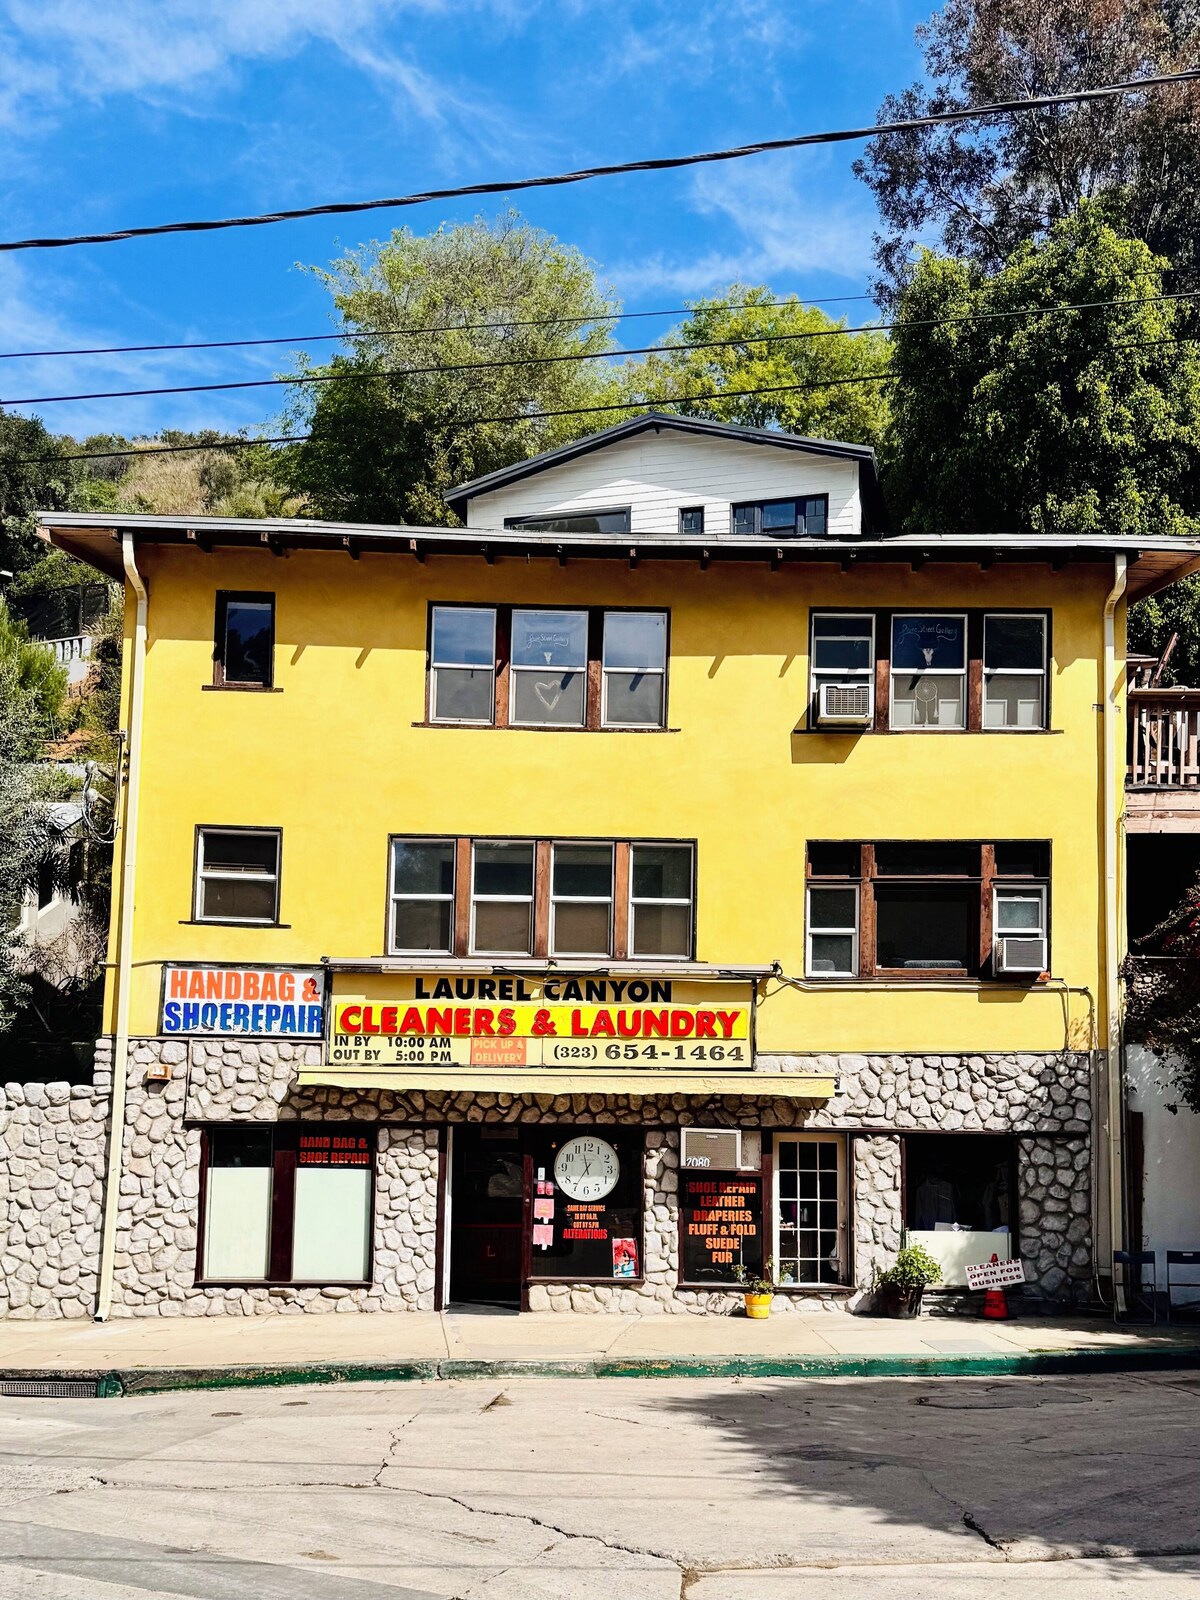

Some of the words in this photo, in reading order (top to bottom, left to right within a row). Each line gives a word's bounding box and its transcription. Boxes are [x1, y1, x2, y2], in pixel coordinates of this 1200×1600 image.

[170, 970, 295, 1001] HANDBAG
[302, 978, 320, 1003] &
[415, 977, 531, 1000] LAUREL
[544, 979, 672, 1003] CANYON
[340, 1005, 517, 1036] CLEANERS
[531, 1009, 557, 1037] &
[571, 1009, 741, 1039] LAUNDRY
[334, 1036, 348, 1046] IN
[354, 1036, 370, 1047] BY
[388, 1037, 425, 1048] 10:00
[429, 1037, 451, 1048] AM
[473, 1038, 498, 1049] PICK
[501, 1038, 514, 1049] UP
[517, 1039, 524, 1049] &
[333, 1050, 360, 1060] OUT
[365, 1050, 381, 1061] BY
[396, 1051, 425, 1061] 5:00
[431, 1051, 451, 1062] PM
[475, 1052, 522, 1063] DELIVERY
[554, 1045, 597, 1060] (323)
[605, 1044, 744, 1061] 654-1464
[300, 1137, 330, 1148] HAND
[333, 1137, 355, 1148] BAG
[358, 1138, 368, 1148] &
[584, 1143, 593, 1152] 12
[575, 1145, 580, 1154] 11
[300, 1152, 328, 1163] SHOE
[331, 1152, 369, 1164] REPAIR
[566, 1153, 574, 1162] 10
[604, 1154, 610, 1163] 2
[561, 1162, 567, 1172] 9
[606, 1165, 613, 1174] 3
[565, 1175, 571, 1184] 8
[573, 1182, 578, 1191] 7
[583, 1186, 589, 1195] 6
[594, 1183, 600, 1192] 5
[689, 1182, 717, 1193] SHOE
[719, 1182, 756, 1193] REPAIR
[701, 1196, 745, 1207] LEATHER
[693, 1210, 752, 1221] DRAPERIES
[563, 1228, 607, 1239] ALTERATIONS
[689, 1224, 718, 1235] FLUFF
[720, 1226, 729, 1235] &
[731, 1224, 756, 1235] FOLD
[706, 1238, 740, 1249] SUEDE
[712, 1252, 733, 1263] FUR
[967, 1259, 1020, 1271] CLEANERS
[970, 1270, 997, 1279] OPEN
[1000, 1266, 1020, 1275] FOR
[972, 1274, 1022, 1287] BUSINESS
